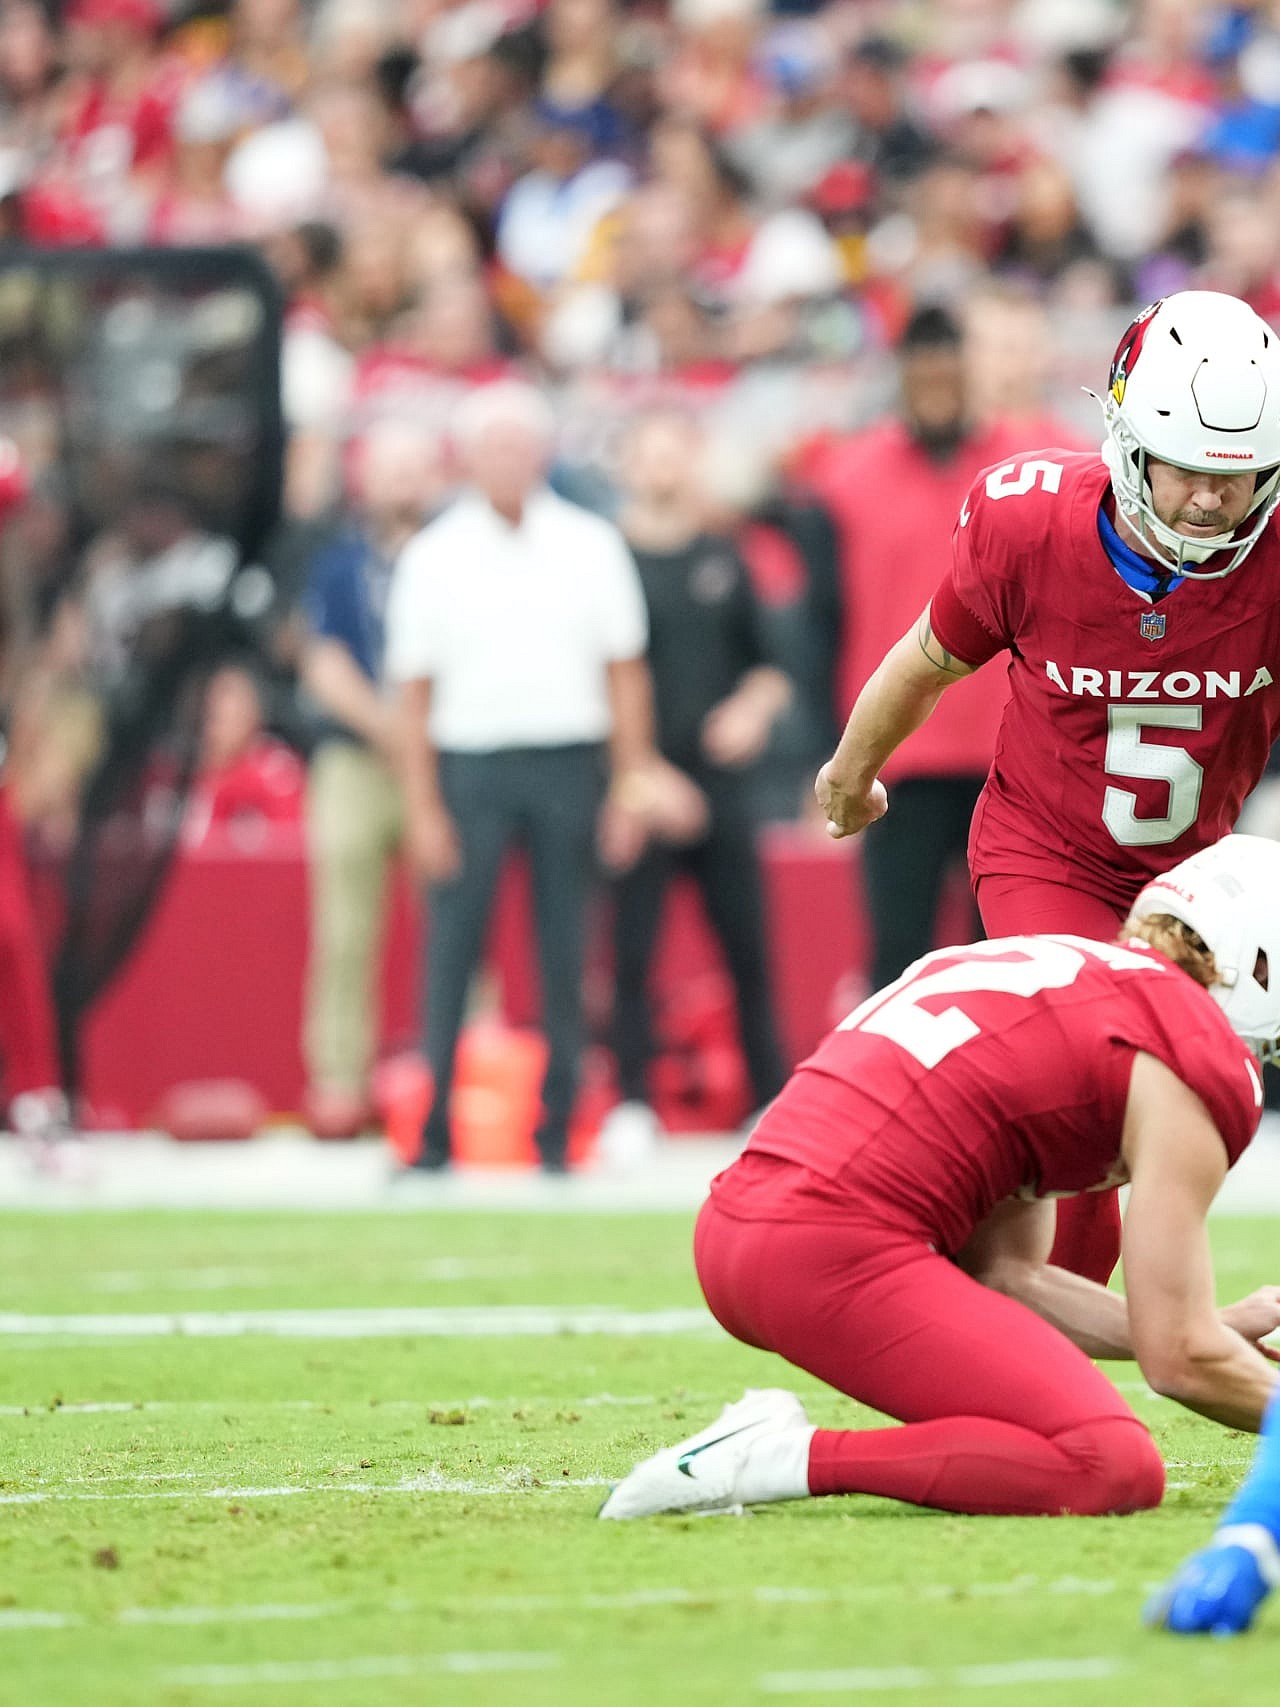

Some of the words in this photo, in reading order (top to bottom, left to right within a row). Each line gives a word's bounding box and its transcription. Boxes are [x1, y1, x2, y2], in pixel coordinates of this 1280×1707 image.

[1205, 451, 1254, 460] CARDINALS
[985, 459, 1064, 500] 5
[1046, 660, 1273, 699] ARIZONA
[1101, 704, 1203, 847] 5
